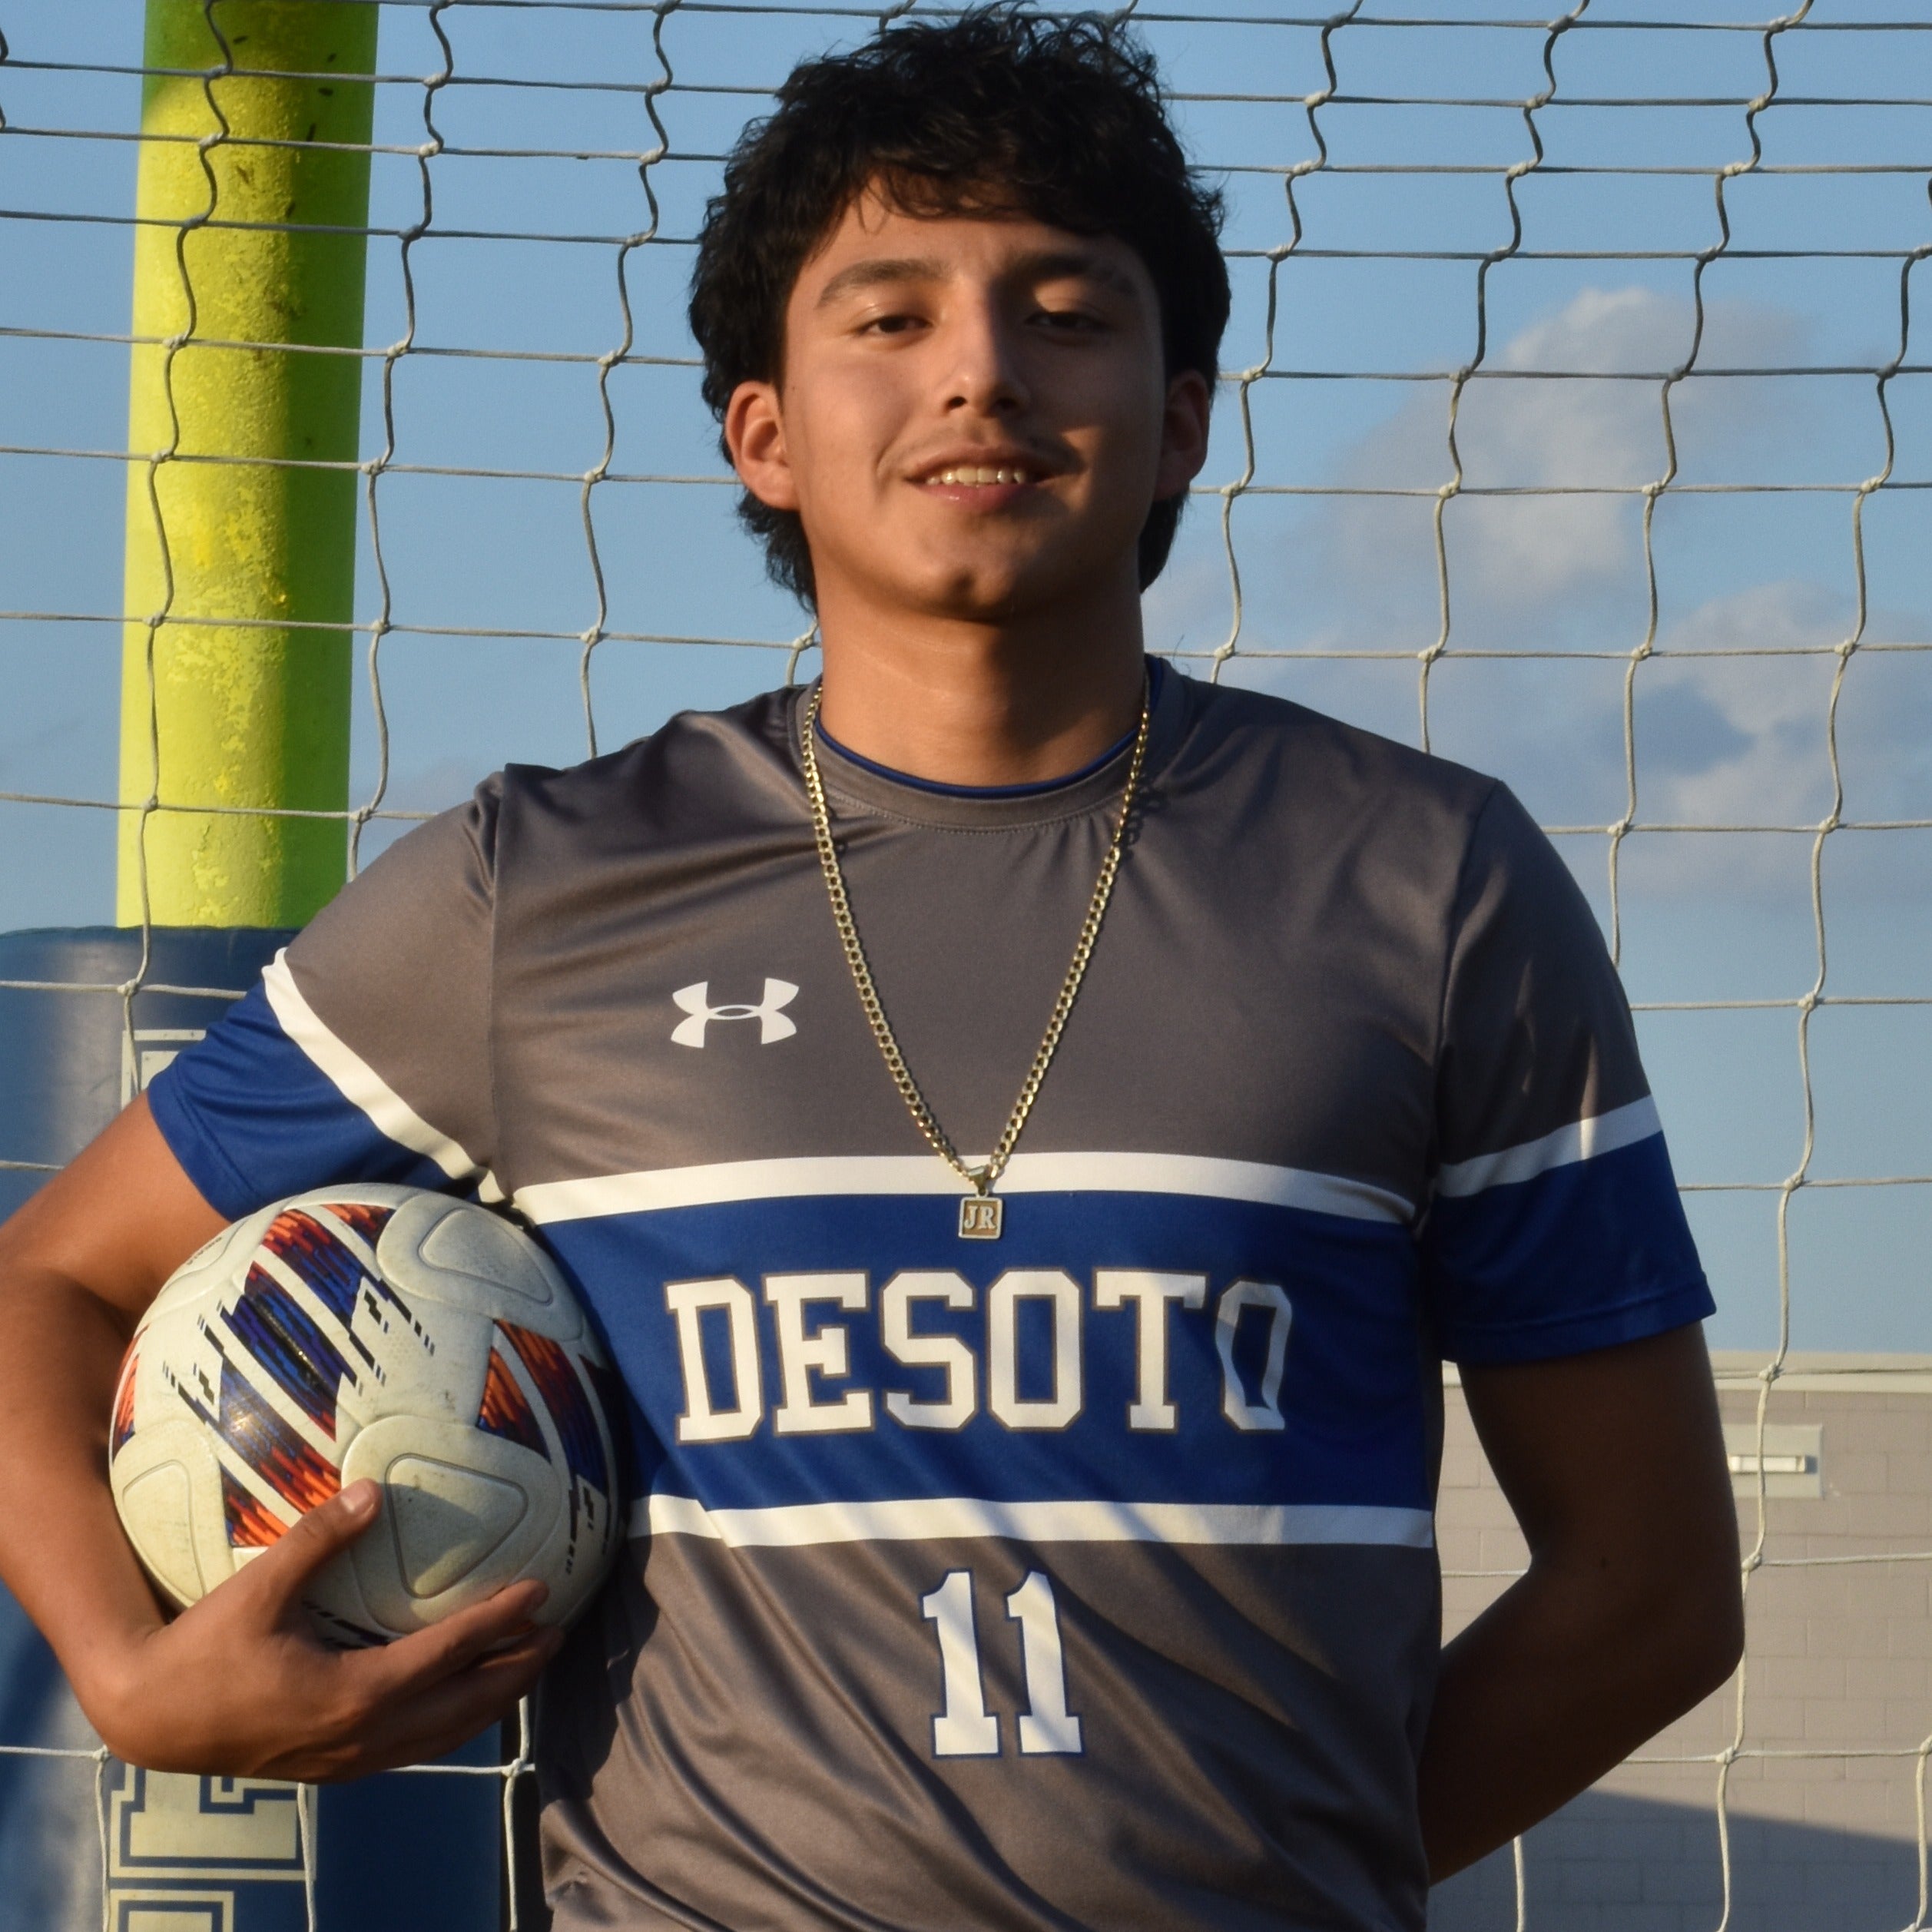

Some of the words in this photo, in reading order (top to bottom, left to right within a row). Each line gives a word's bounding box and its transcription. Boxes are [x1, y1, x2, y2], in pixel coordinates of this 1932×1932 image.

[963, 1205, 996, 1229] JR
[664, 1269, 1292, 1443] DESOTO
[921, 1569, 1084, 1757] 11
